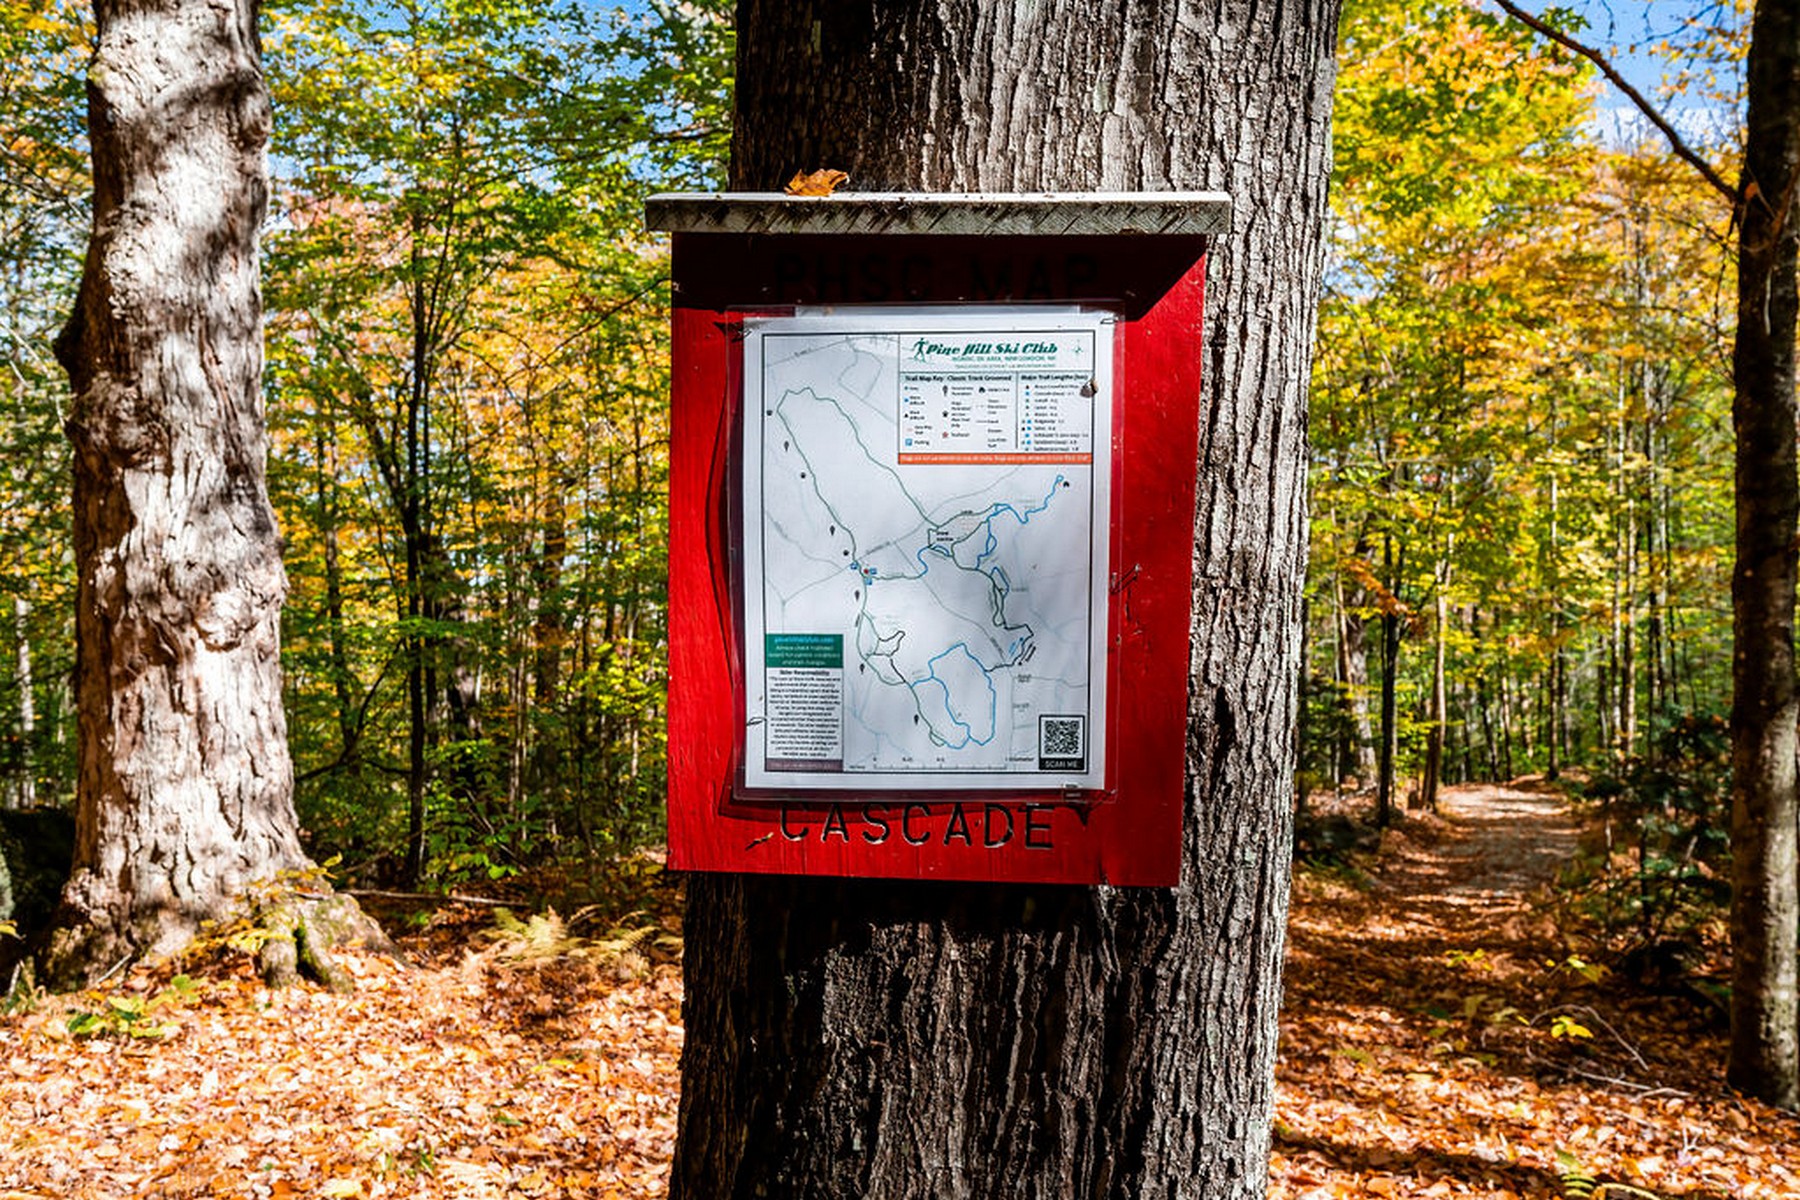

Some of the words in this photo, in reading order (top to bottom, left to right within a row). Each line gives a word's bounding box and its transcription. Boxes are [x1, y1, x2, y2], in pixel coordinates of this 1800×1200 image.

[773, 252, 933, 301] PHSC
[969, 250, 1098, 301] MAP
[926, 343, 961, 356] Pine
[962, 342, 993, 356] Hill
[994, 342, 1020, 355] Ski
[1022, 341, 1059, 355] Club
[1044, 760, 1066, 769] SCAN
[1067, 760, 1079, 769] ME
[780, 801, 1054, 849] CASCADE
